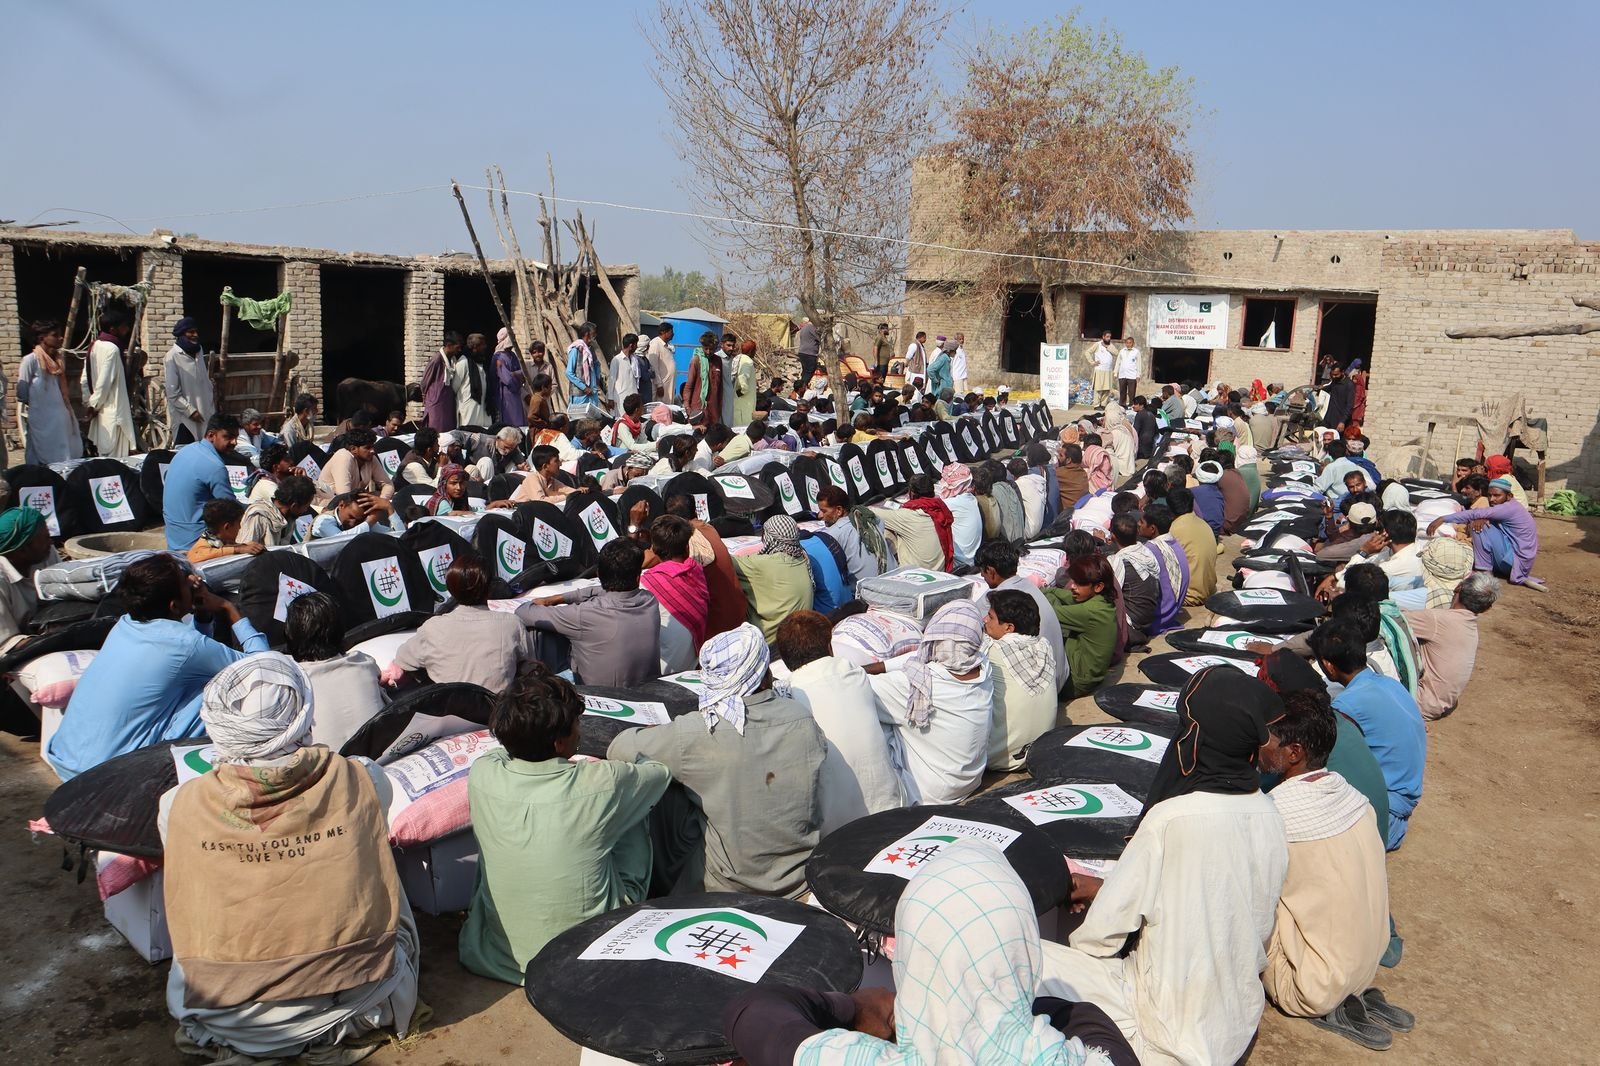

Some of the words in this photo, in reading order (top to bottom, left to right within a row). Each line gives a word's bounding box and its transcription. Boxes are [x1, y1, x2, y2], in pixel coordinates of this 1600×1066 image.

[295, 832, 321, 844] AND
[926, 826, 1004, 844] KHUBAIB
[930, 822, 1009, 839] FOUNDATION
[239, 852, 271, 863] LOVE
[278, 847, 305, 860] YOU
[600, 911, 661, 955] FOUNDATION
[612, 912, 673, 955] KHUBAIB
